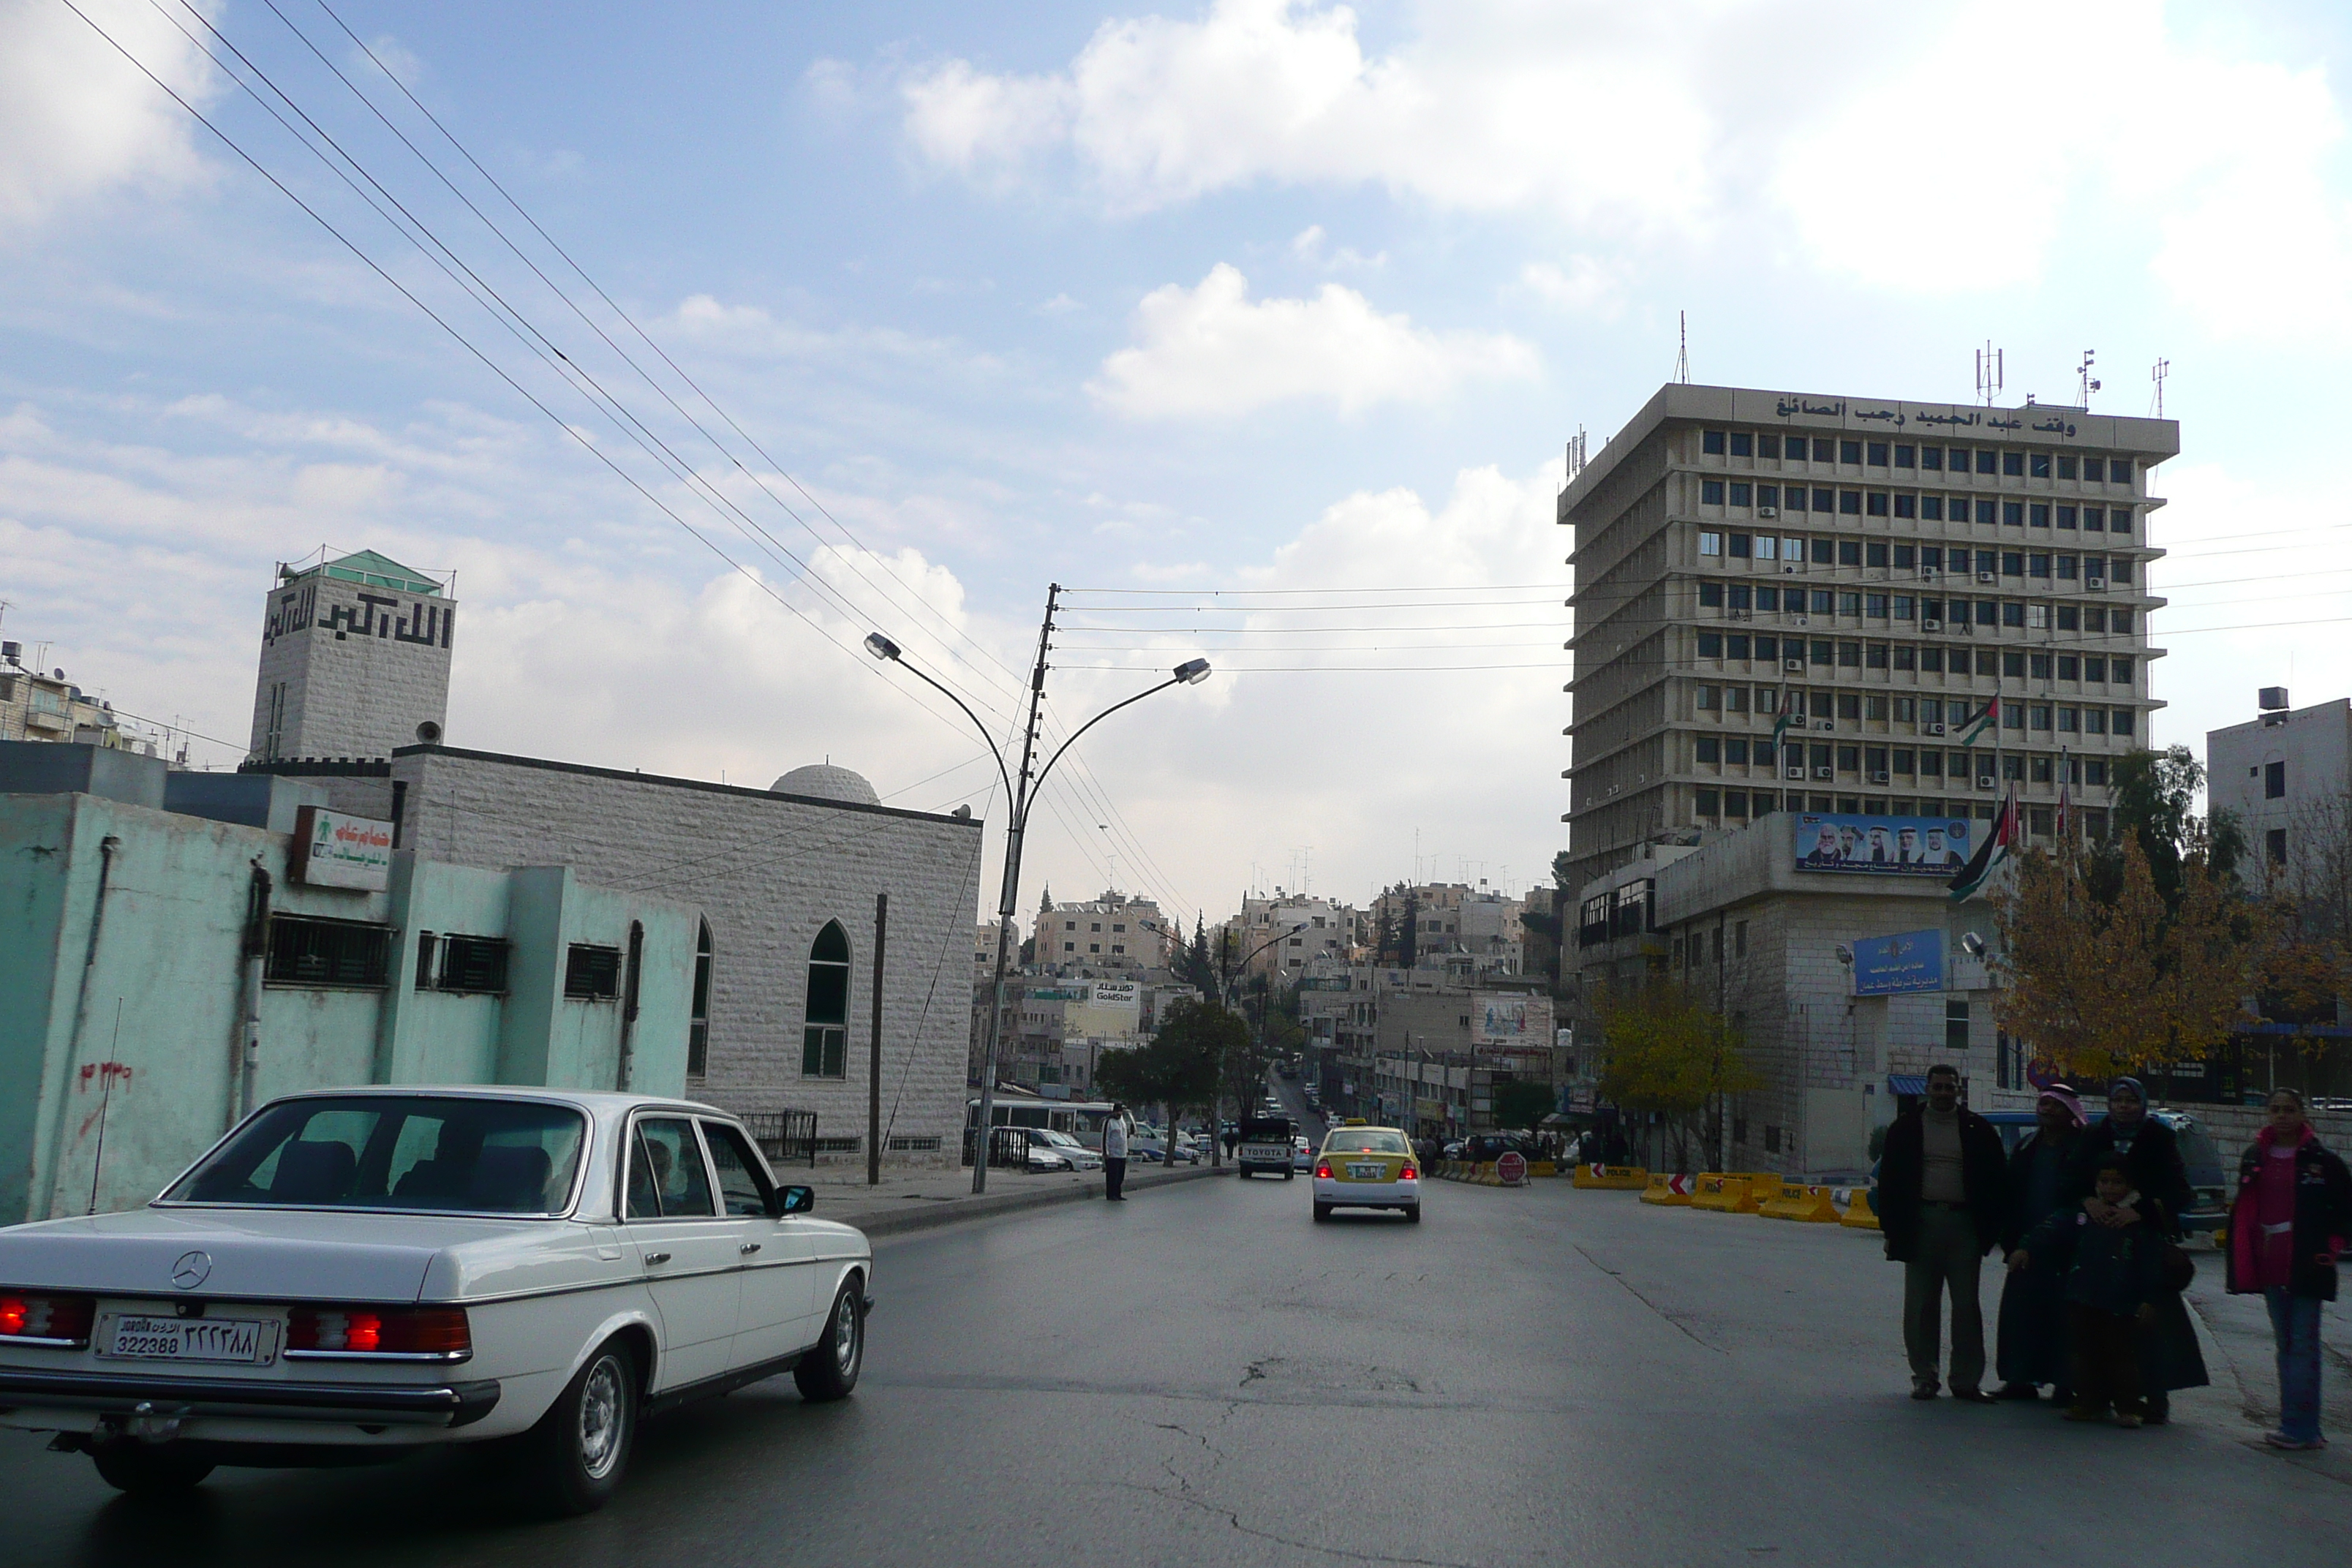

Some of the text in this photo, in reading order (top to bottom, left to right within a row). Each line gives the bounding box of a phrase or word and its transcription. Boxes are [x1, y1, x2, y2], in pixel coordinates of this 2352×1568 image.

[1776, 397, 2076, 437] وقف عبد الحميد رجب الصائغ
[1901, 864, 1964, 873] الهاشميون
[1096, 992, 1134, 1002] GoldStar
[1606, 1169, 1632, 1177] POLICE
[121, 1320, 151, 1333] JORDAN
[117, 1336, 178, 1354] 322388
